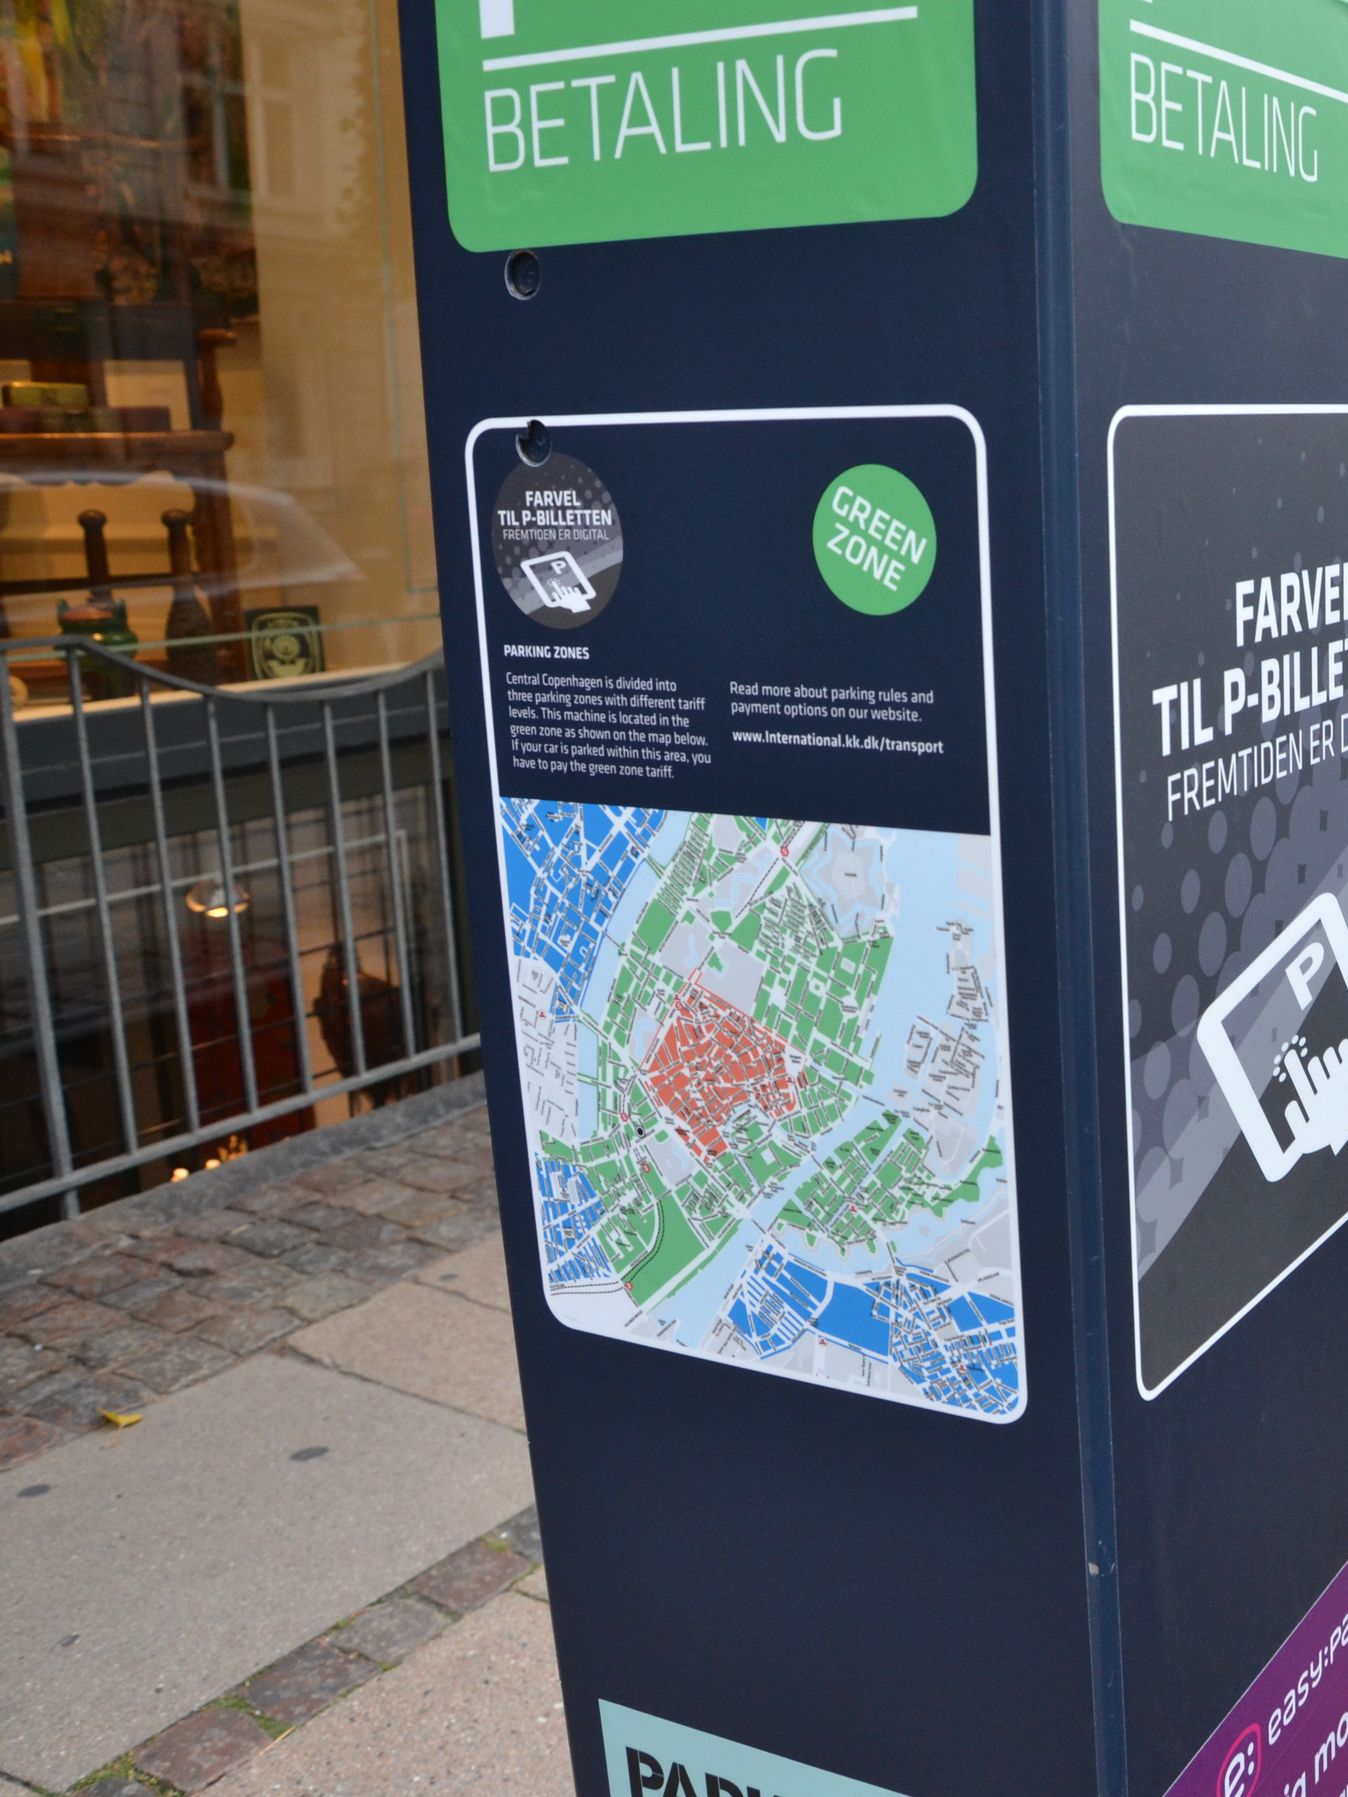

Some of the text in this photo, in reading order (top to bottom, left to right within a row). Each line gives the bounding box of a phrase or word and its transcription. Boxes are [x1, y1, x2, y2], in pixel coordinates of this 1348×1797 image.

[484, 49, 842, 172] BETALING
[1130, 53, 1317, 182] BETALING
[526, 491, 580, 507] FARVEL
[497, 510, 612, 526] TIL P-BILLETTEN
[832, 485, 927, 565] GREEN
[503, 529, 609, 539] FREMTIDEN ER DIGITAL
[551, 561, 566, 574] P
[826, 523, 906, 591] ZONE
[504, 645, 589, 659] PARKING ZONES
[506, 672, 677, 692] Central Copenhagen is divided into
[730, 681, 934, 704] Read more about parking rules and
[507, 690, 705, 711] three parking zones with different tariff
[731, 702, 922, 722] payment options on our website.
[509, 706, 689, 727] levels. This machine is located in the
[1152, 677, 1213, 757] TIL
[510, 725, 708, 746] green zone as shown on the map below.
[733, 730, 944, 755] www.International.kk.dk/transport
[512, 739, 711, 766] If your car is parked within this area, you
[513, 756, 674, 779] have to pay the green zone tariff.
[1167, 729, 1302, 821] FREMTIDEN
[1310, 720, 1334, 765] ER
[1285, 942, 1324, 1010] P
